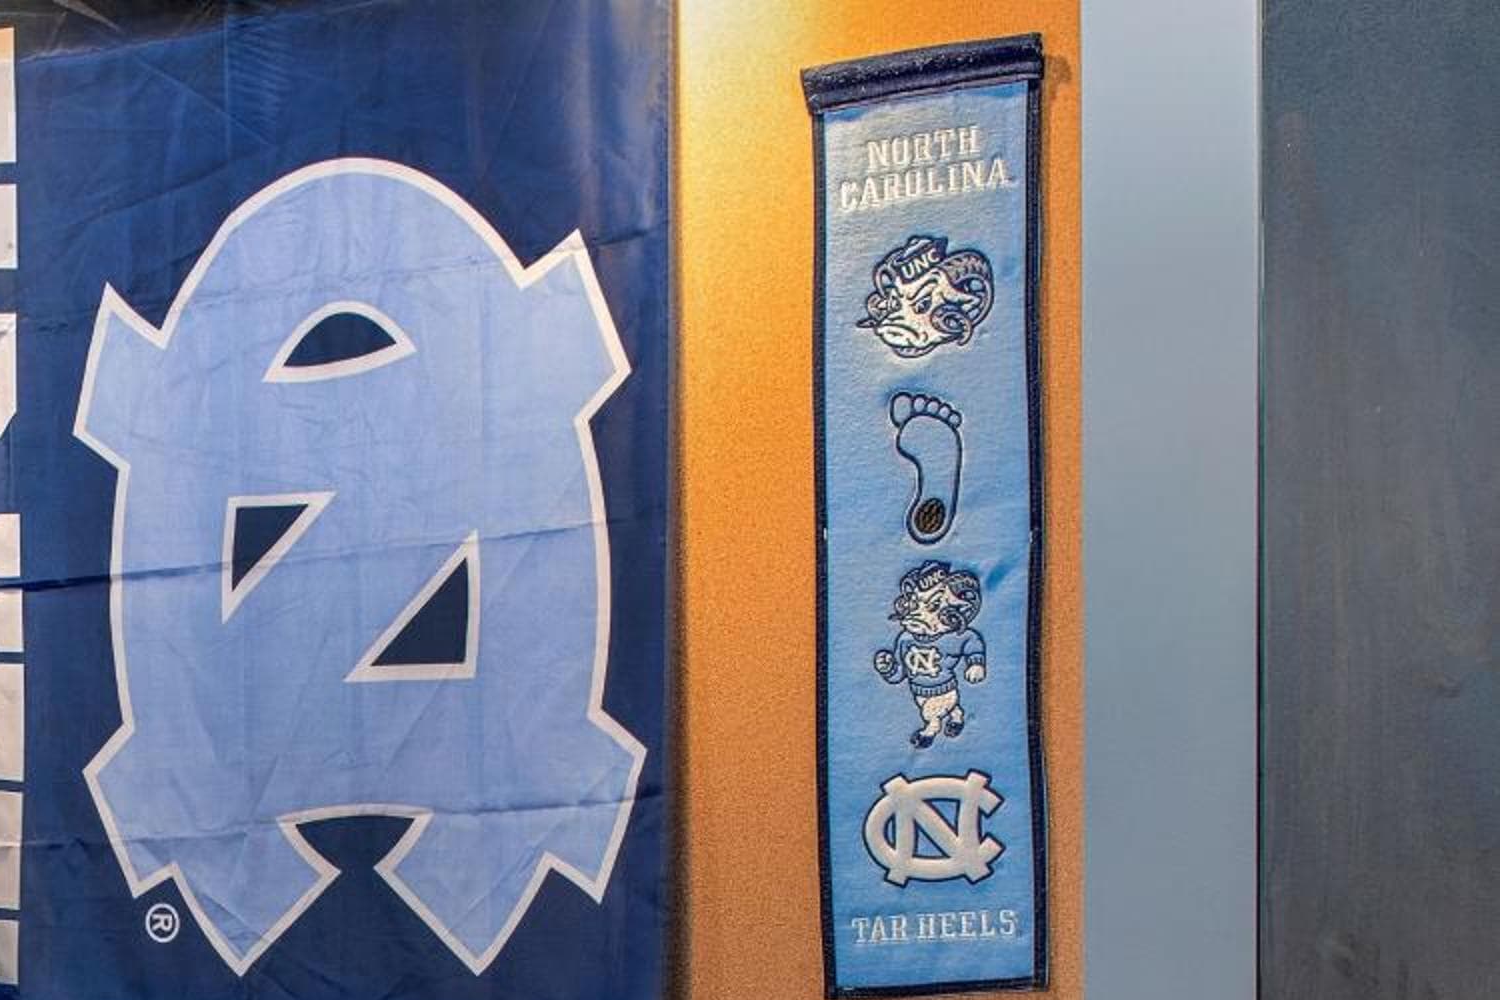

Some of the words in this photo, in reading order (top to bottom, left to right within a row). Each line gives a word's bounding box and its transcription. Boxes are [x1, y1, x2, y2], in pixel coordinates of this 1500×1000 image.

[867, 126, 981, 173] NORTH
[840, 158, 1012, 212] CAROLINA
[901, 250, 942, 279] UNC
[919, 569, 946, 589] UNC
[852, 915, 909, 943] TAR
[916, 910, 1018, 939] HEELS
